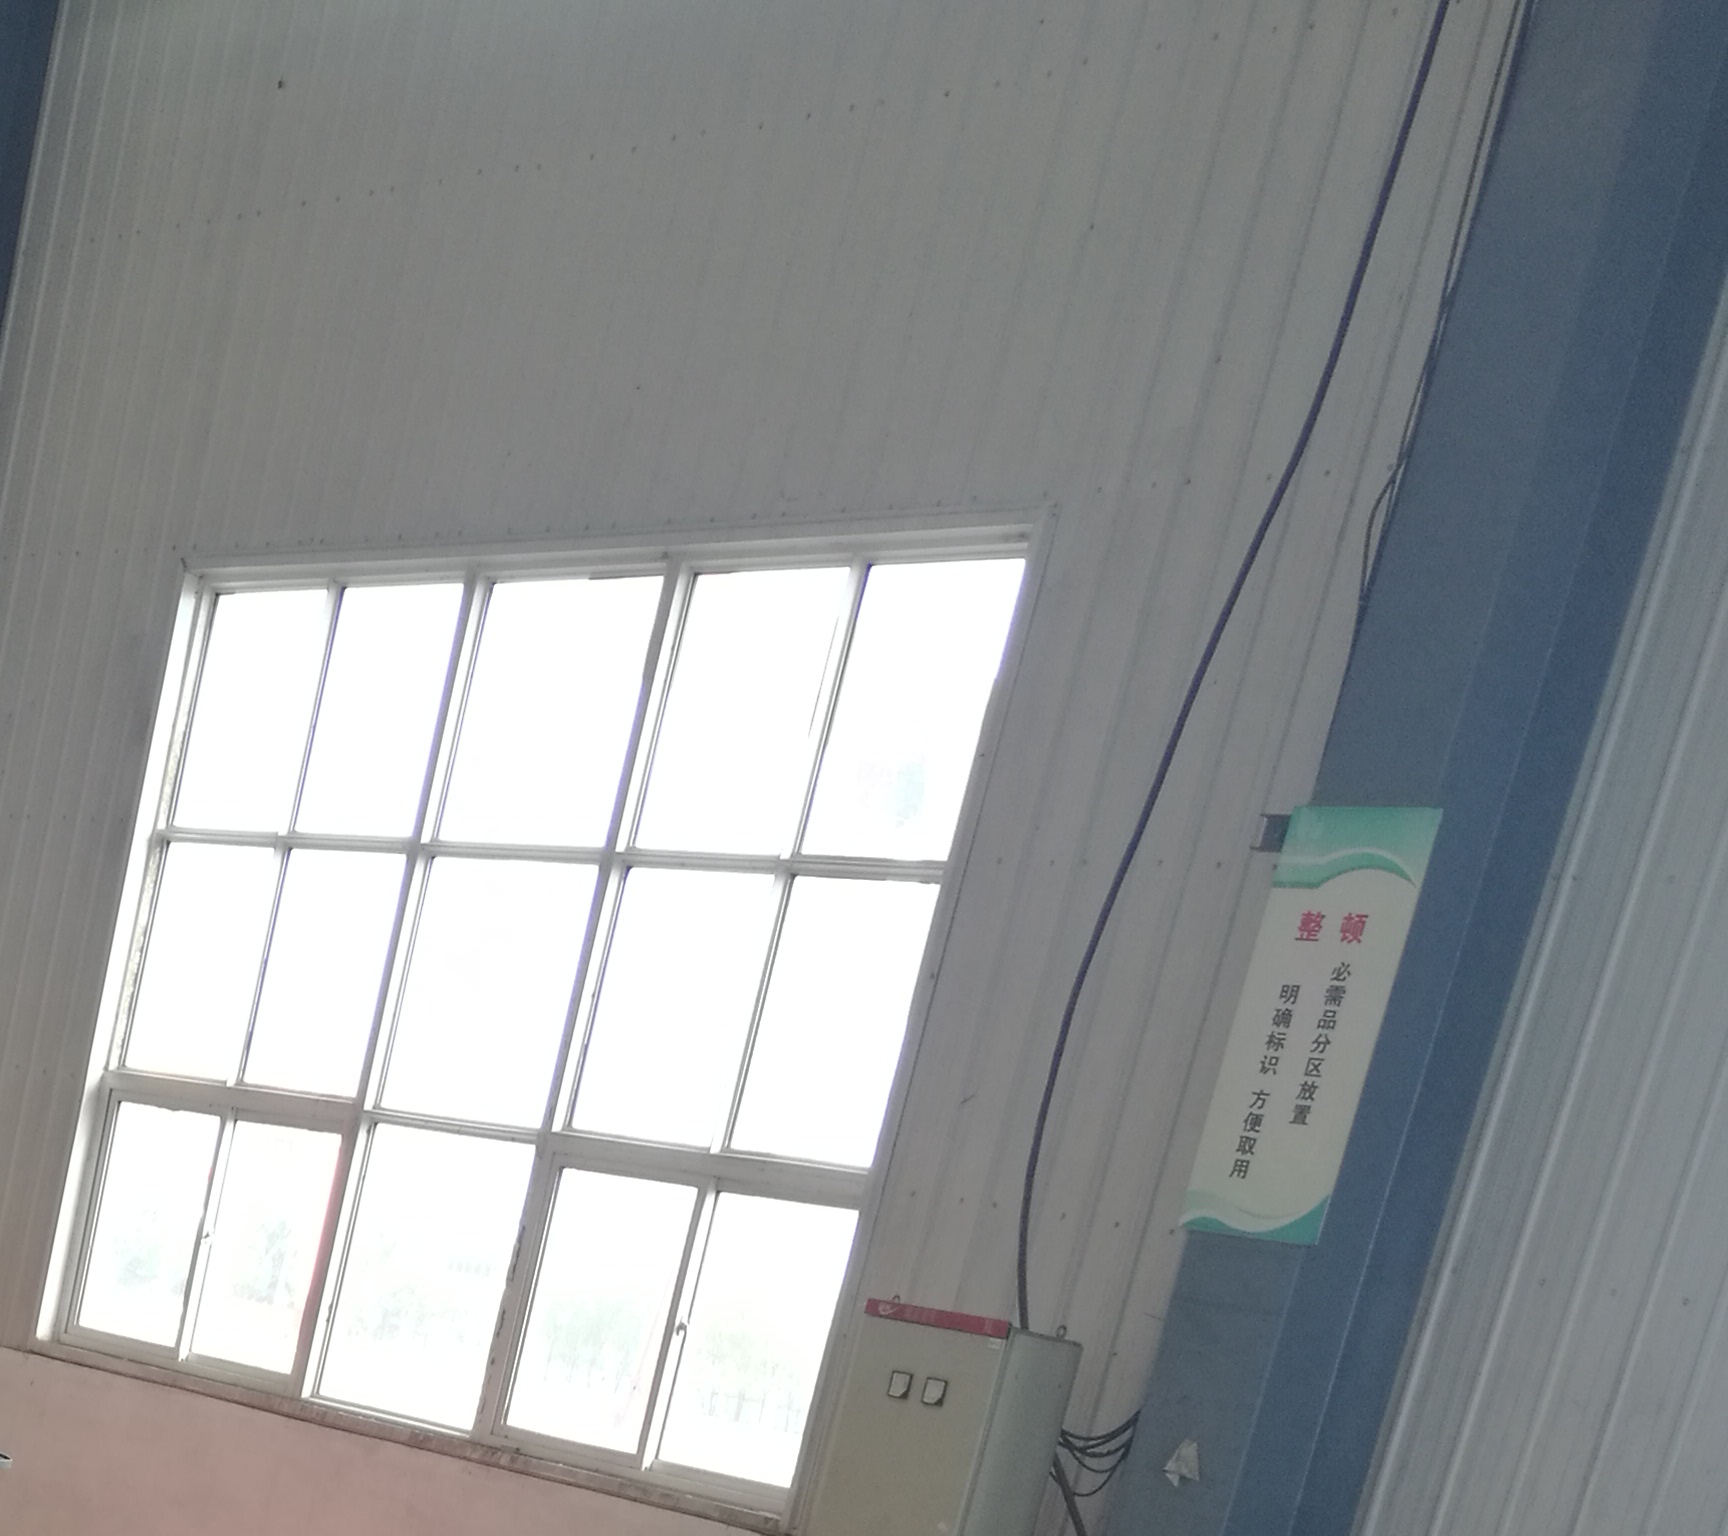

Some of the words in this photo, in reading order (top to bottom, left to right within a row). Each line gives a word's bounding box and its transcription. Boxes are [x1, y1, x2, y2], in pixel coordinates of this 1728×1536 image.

[1294, 910, 1369, 944] 整顿
[1288, 961, 1352, 1127] 必需品分区放置
